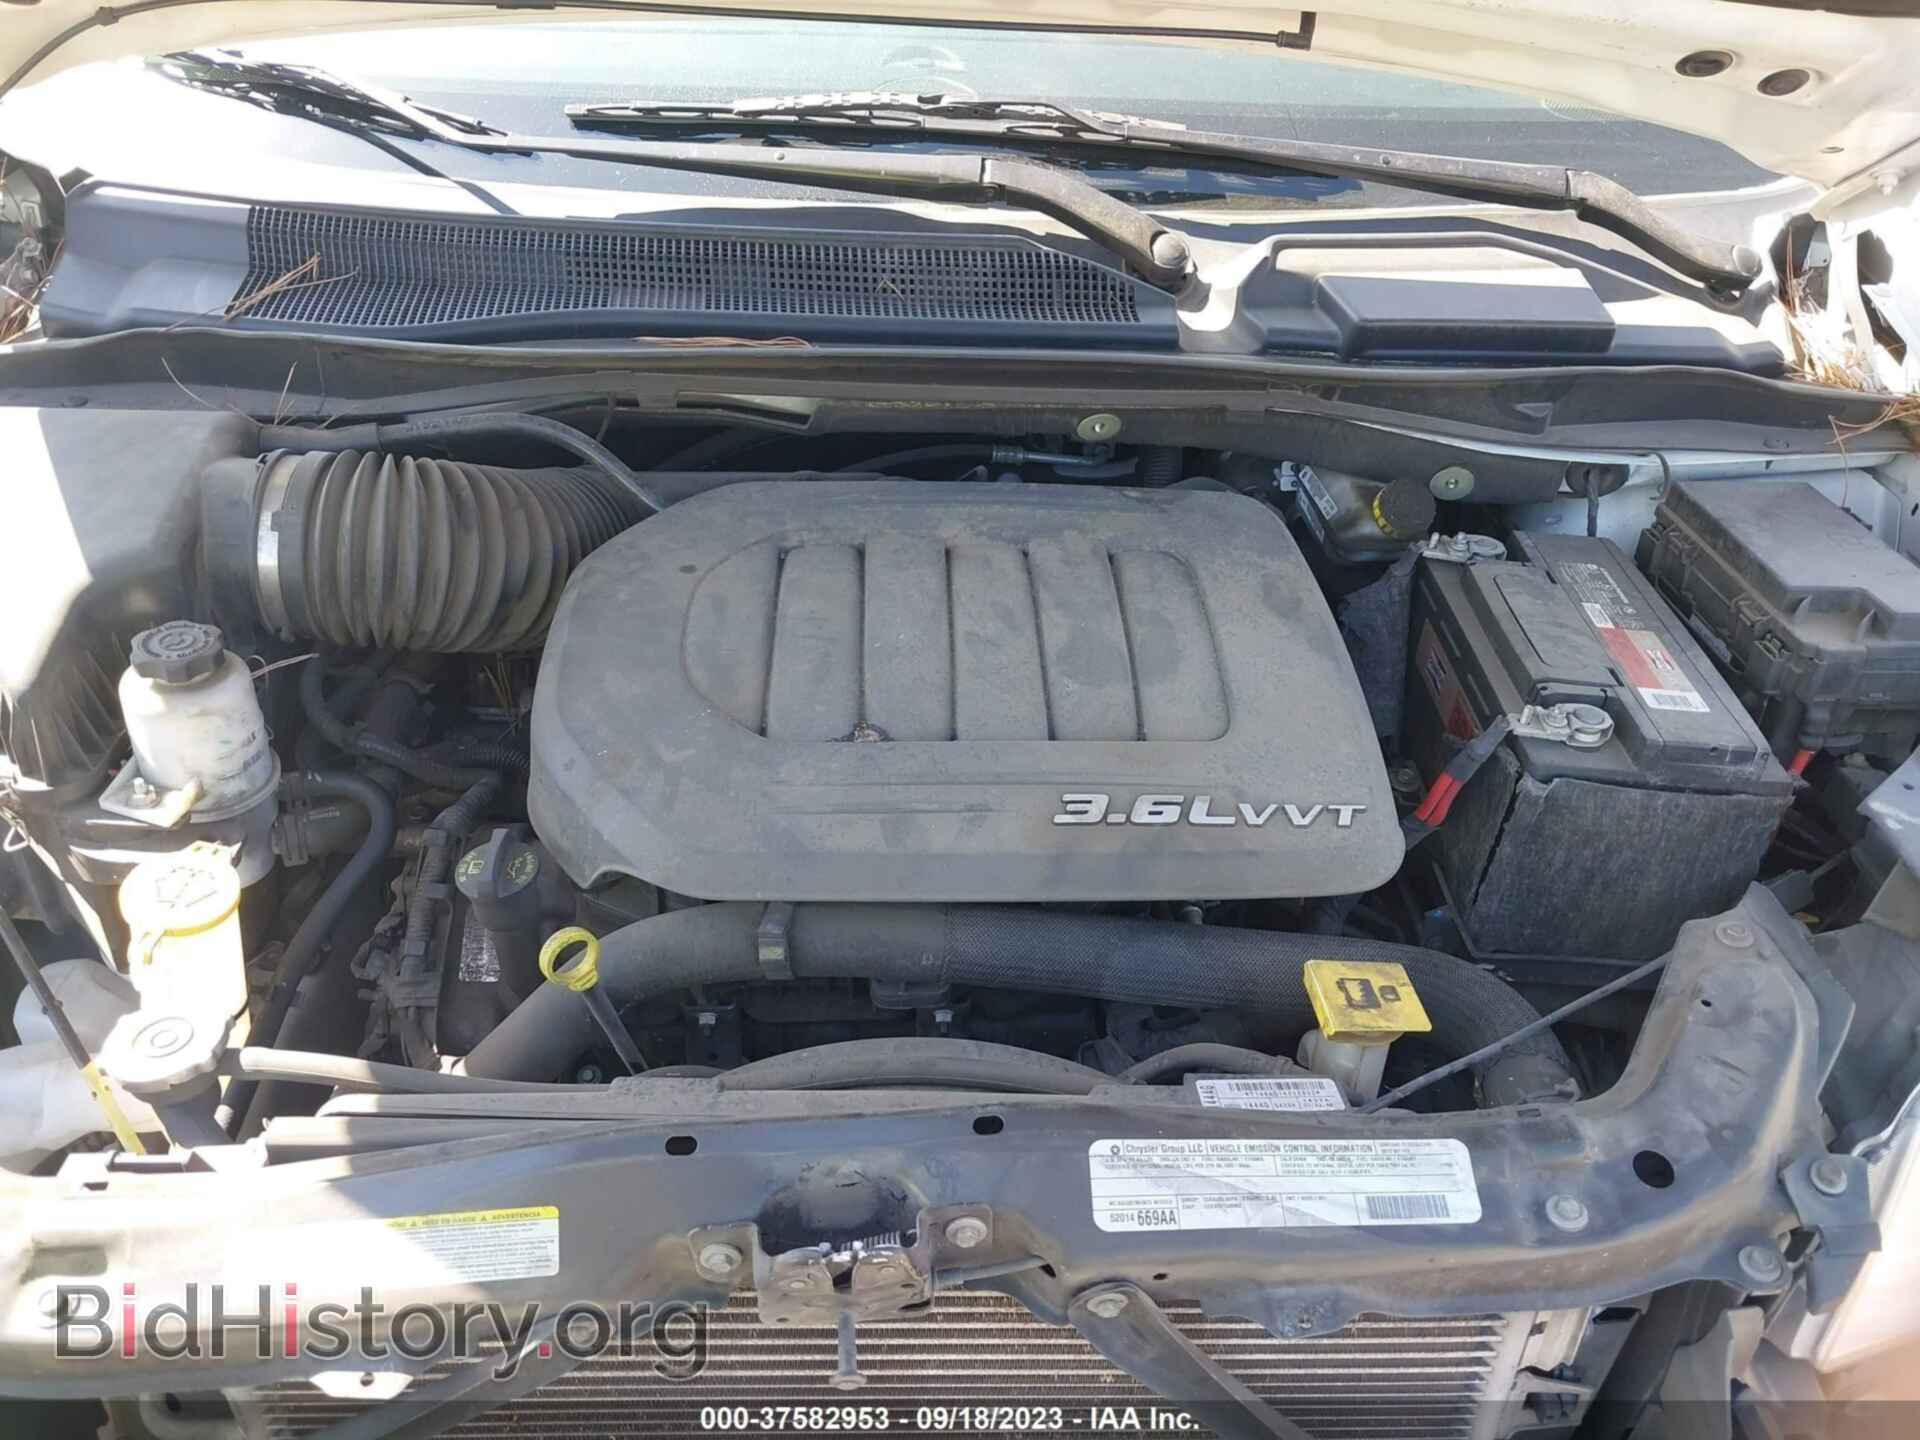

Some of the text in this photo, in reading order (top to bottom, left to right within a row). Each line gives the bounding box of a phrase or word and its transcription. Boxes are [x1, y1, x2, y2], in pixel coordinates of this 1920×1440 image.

[1125, 1143, 1159, 1154] Chrysler
[1160, 1143, 1186, 1154] Group
[1188, 1143, 1204, 1153] LLC
[1209, 1143, 1242, 1153] VEHICLE
[1244, 1143, 1281, 1153] EMISSION
[1283, 1143, 1317, 1153] CONTROL
[1320, 1143, 1374, 1153] INFORMATION
[1137, 1210, 1178, 1226] 669AA
